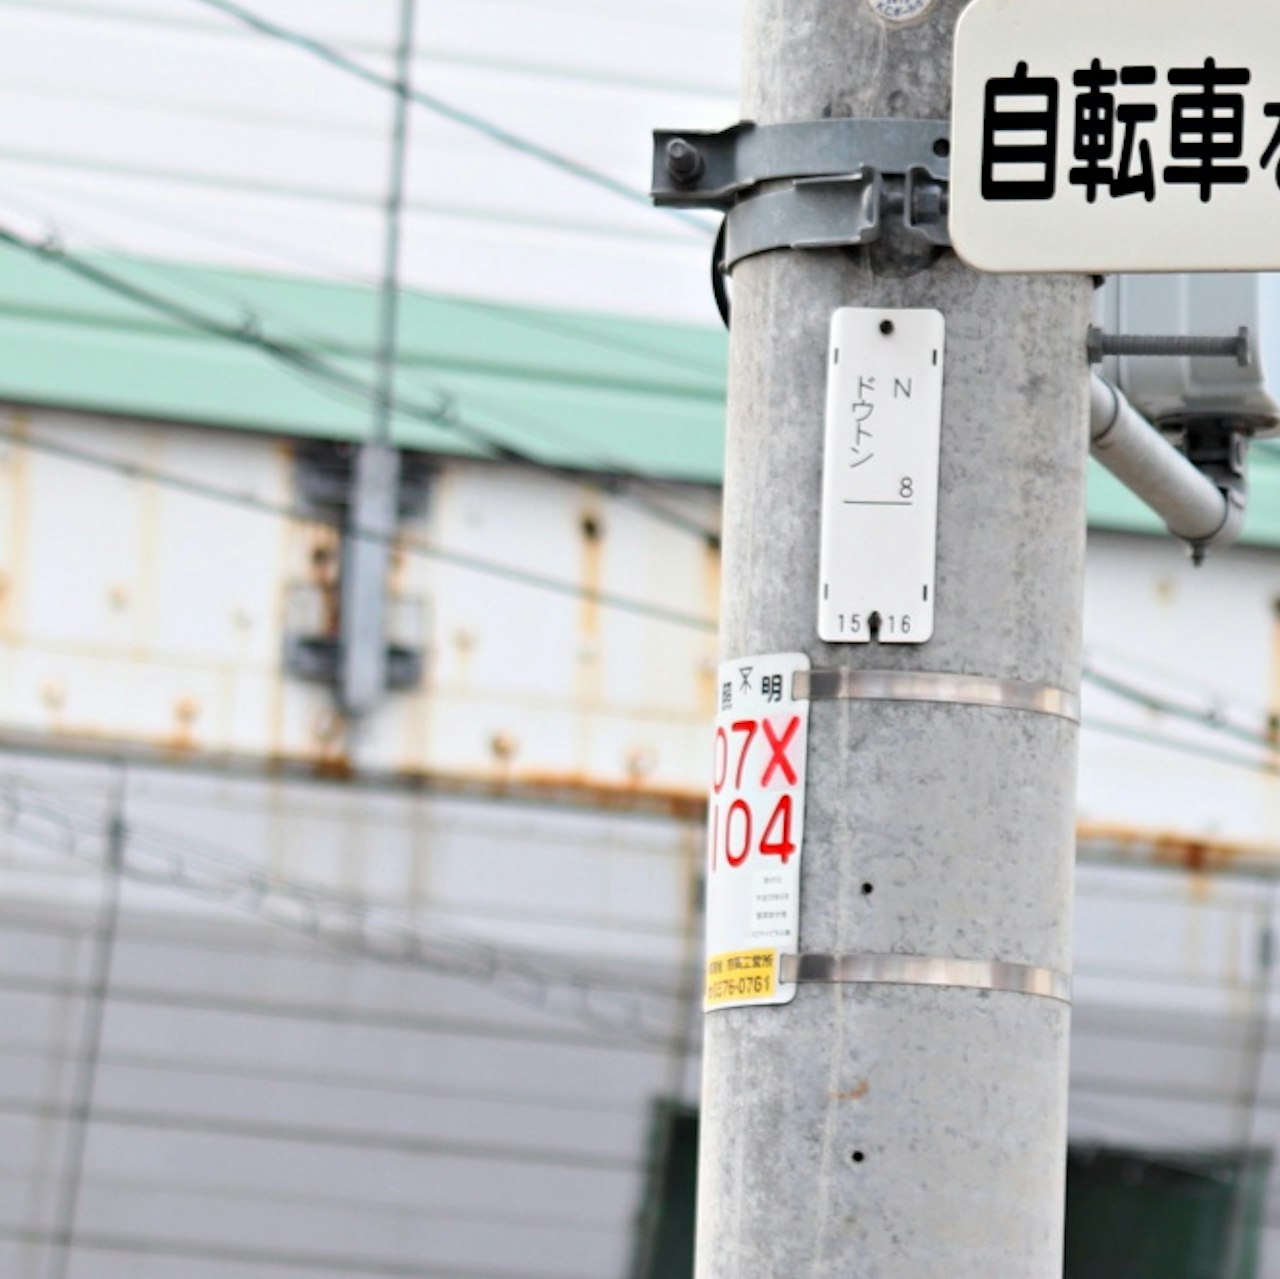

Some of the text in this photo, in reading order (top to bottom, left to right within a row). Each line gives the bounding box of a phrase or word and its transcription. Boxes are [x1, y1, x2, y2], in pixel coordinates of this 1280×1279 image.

[893, 377, 913, 399] N
[850, 375, 876, 468] ドウトン
[899, 476, 914, 498] 8
[838, 613, 911, 634] 15 16
